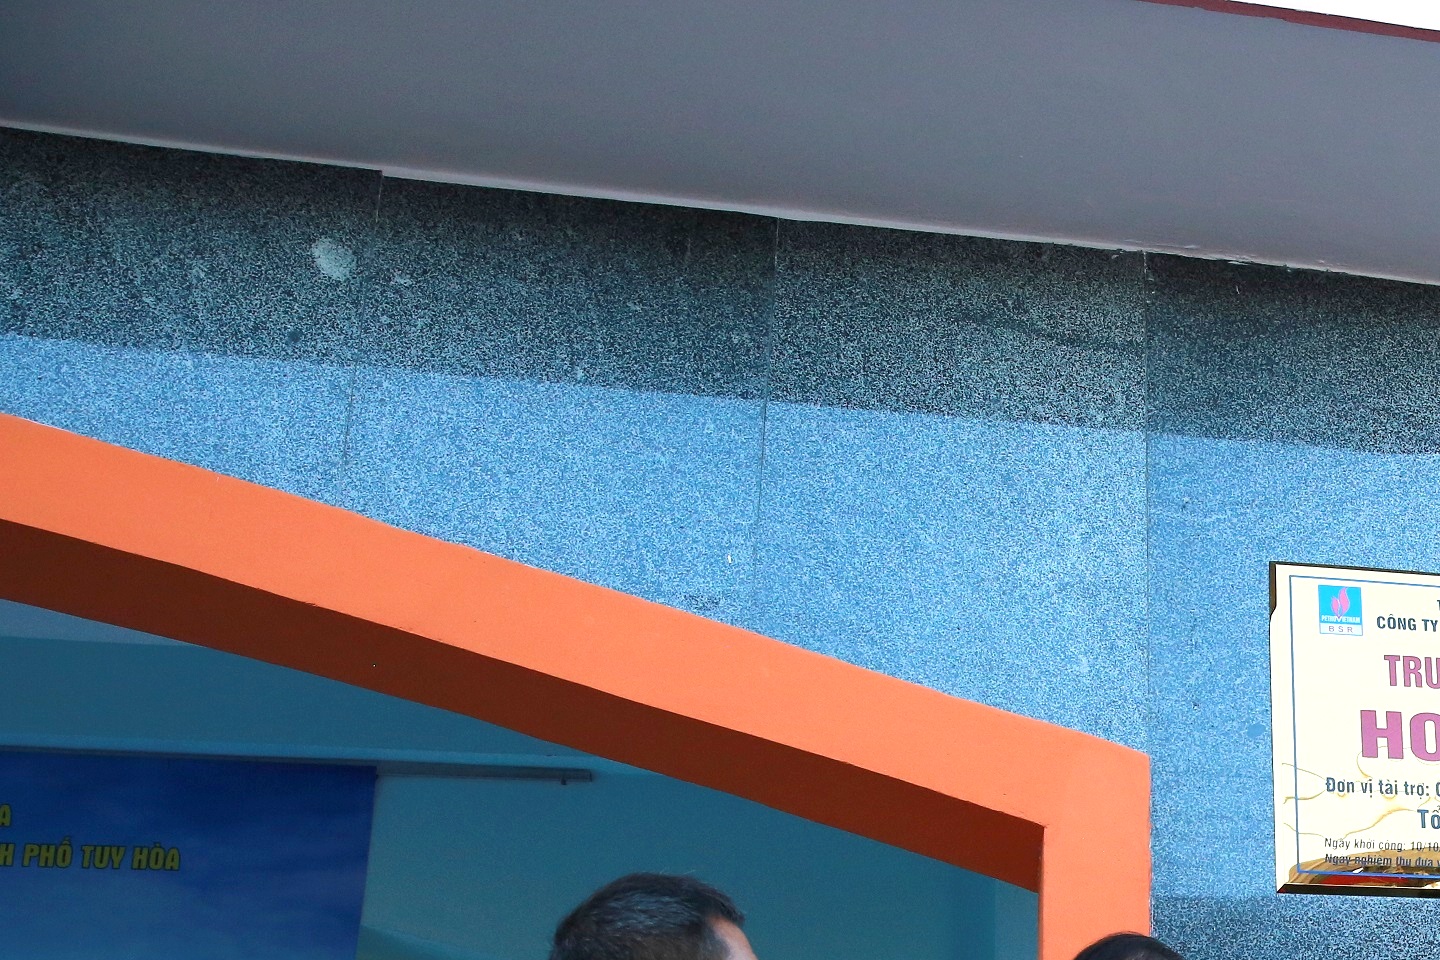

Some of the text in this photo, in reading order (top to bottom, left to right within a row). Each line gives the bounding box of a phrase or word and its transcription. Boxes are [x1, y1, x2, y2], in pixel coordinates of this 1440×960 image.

[1376, 613, 1417, 631] CÔNG
[1421, 618, 1438, 632] TY
[1325, 777, 1355, 794] Đơn
[1361, 779, 1373, 798] vị
[1378, 779, 1398, 796] tài
[1404, 781, 1430, 800] trợ:
[22, 836, 73, 868] PHỐ
[81, 844, 126, 870] TUY
[131, 842, 181, 871] HÒA
[1396, 856, 1411, 867] thu
